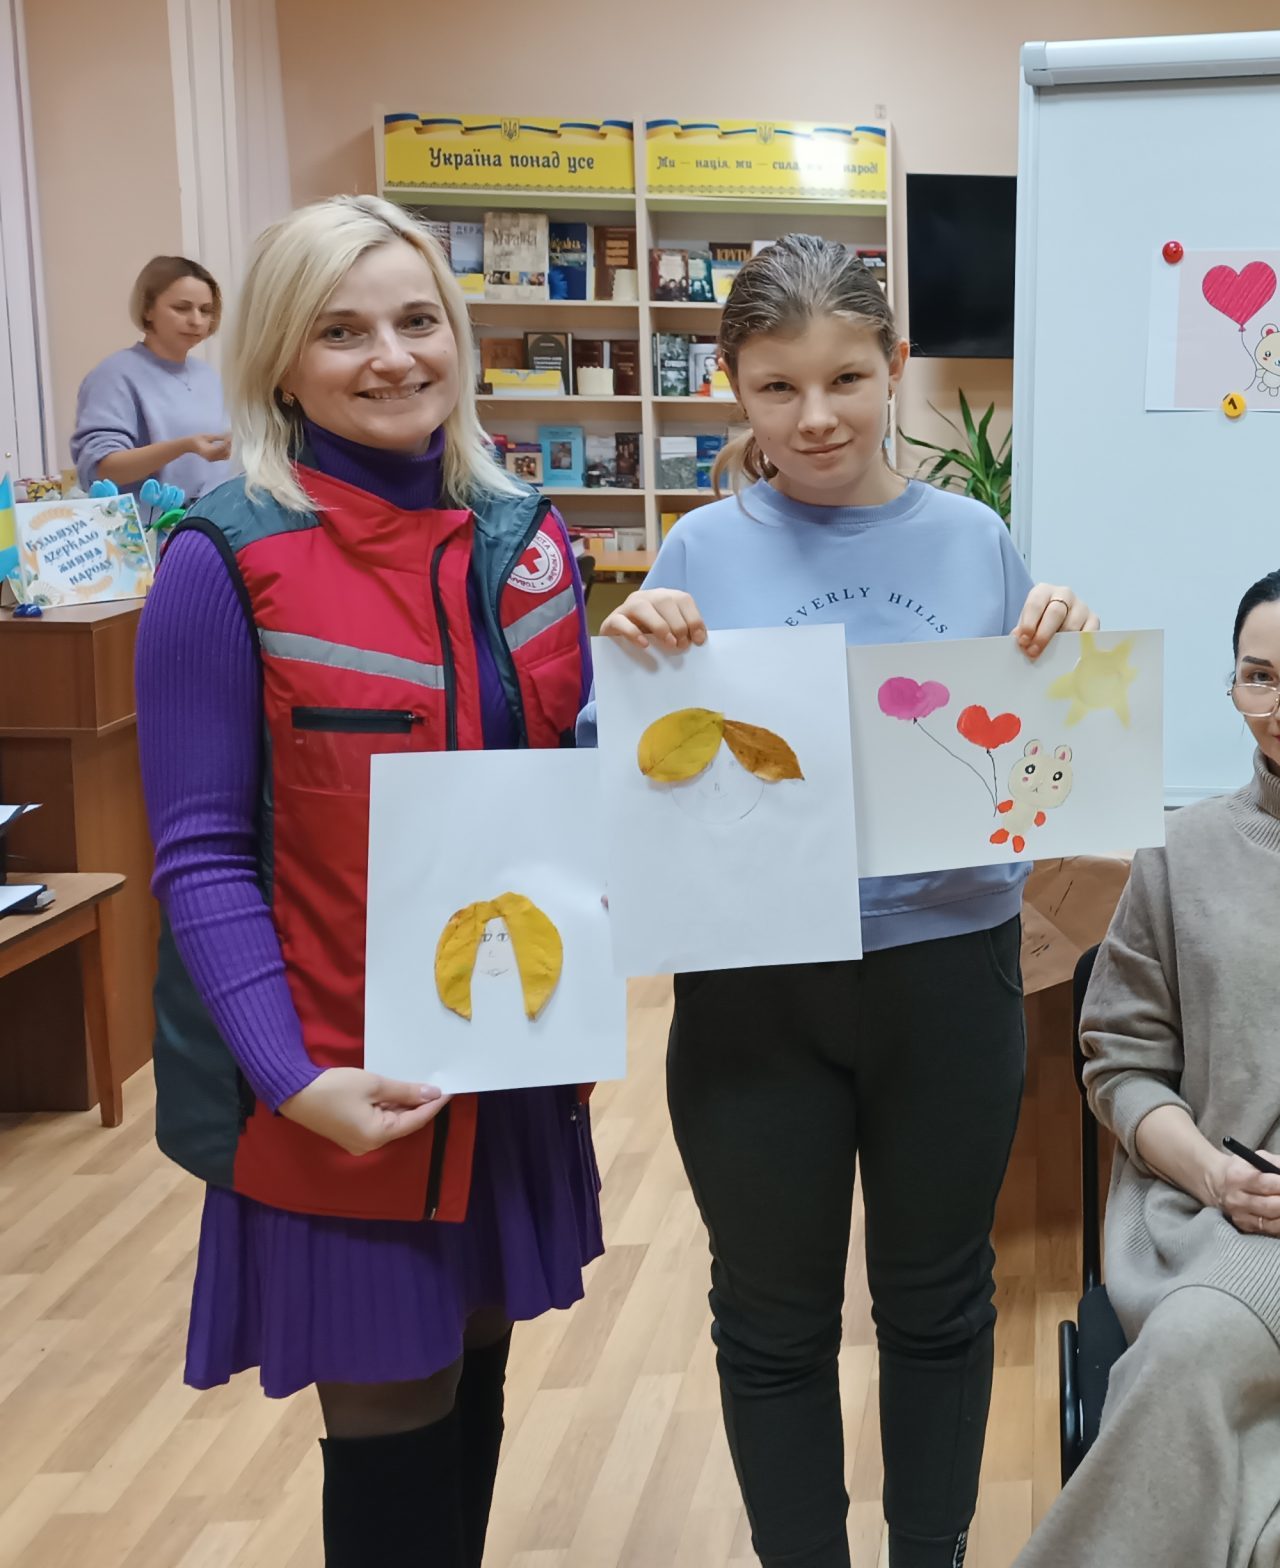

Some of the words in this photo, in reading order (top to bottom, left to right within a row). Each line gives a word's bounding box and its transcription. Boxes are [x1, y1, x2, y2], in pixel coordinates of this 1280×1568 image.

[430, 147, 502, 170] Україна
[510, 151, 560, 169] понад
[568, 155, 595, 173] усе
[656, 156, 675, 170] Ми
[735, 160, 752, 169] ми
[1228, 397, 1238, 410] 1
[784, 586, 870, 627] EVERLY
[888, 592, 948, 634] HILLS
